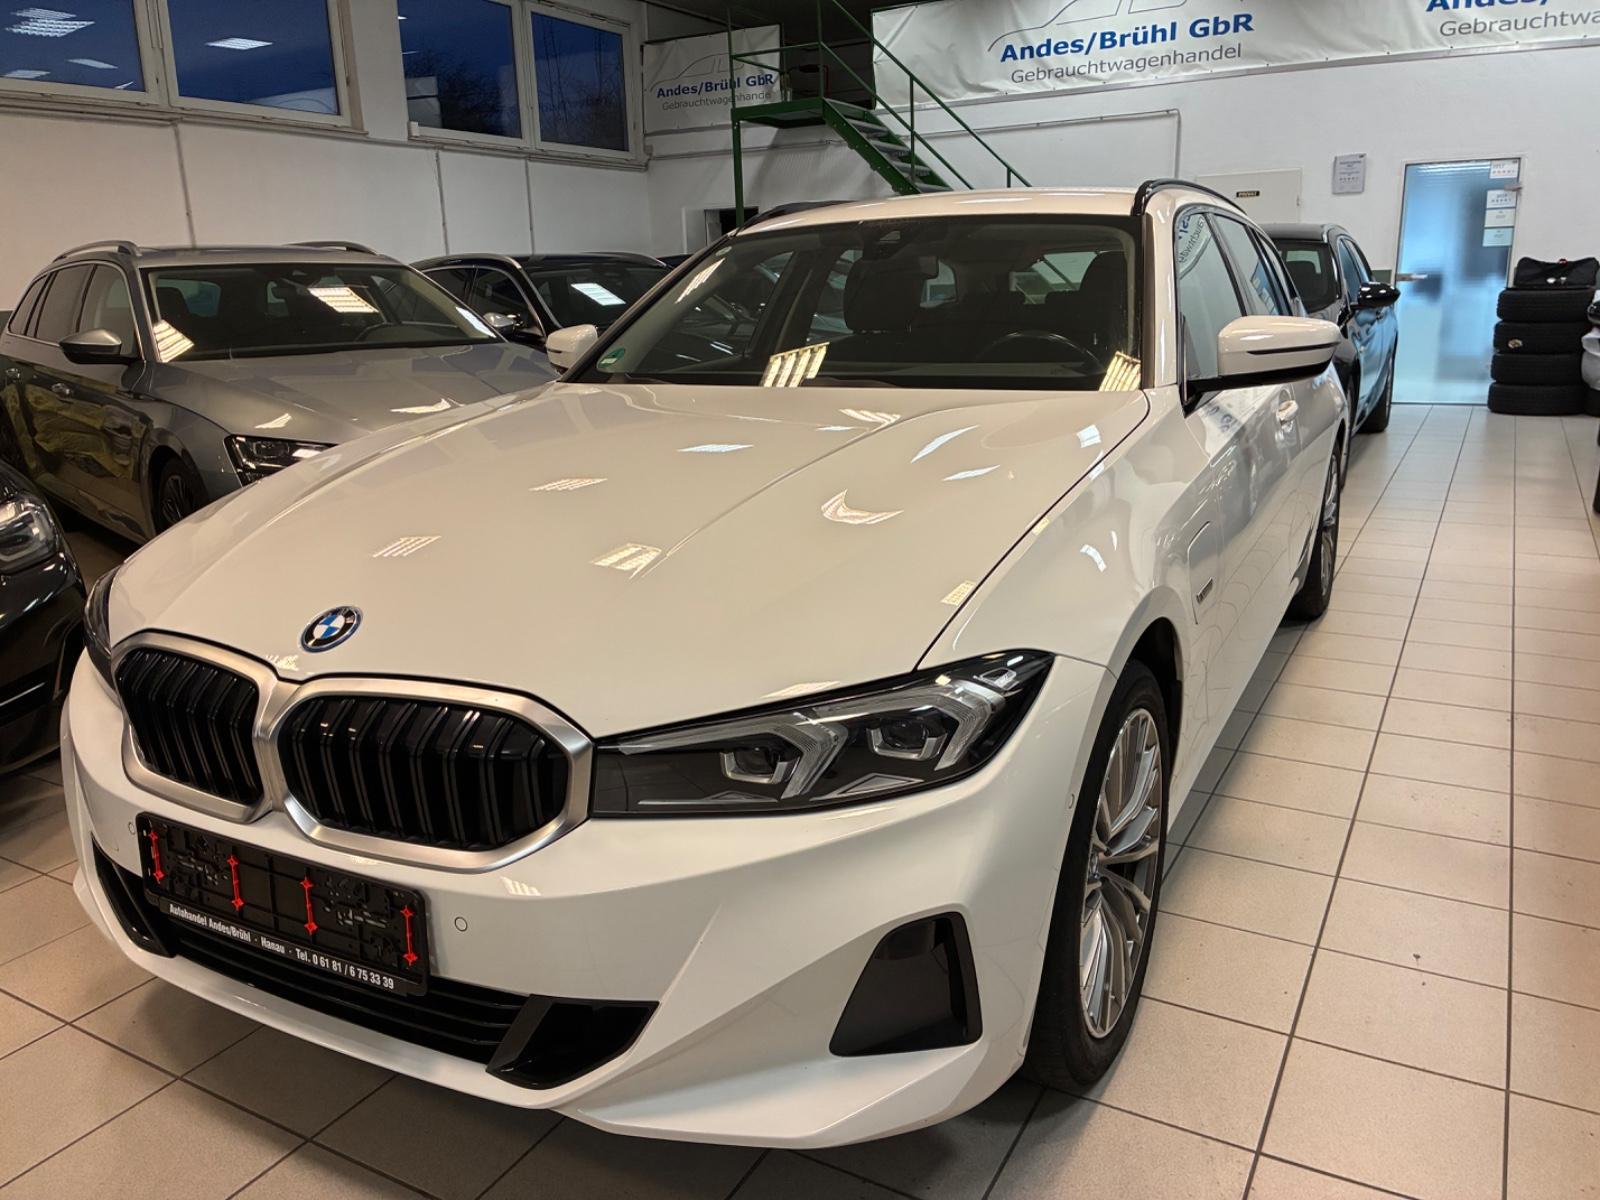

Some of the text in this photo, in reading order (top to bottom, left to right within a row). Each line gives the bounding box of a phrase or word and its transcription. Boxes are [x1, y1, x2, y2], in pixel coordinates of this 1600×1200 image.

[1000, 13, 1255, 62] Andes/Brühl GbR
[745, 73, 774, 87] GbR
[1011, 43, 1242, 84] Gebrauchtwagenhandel
[169, 903, 207, 927] Autohandel
[209, 917, 251, 943] Andes/Brühl
[260, 936, 285, 954] Hanau
[295, 948, 311, 963] Tel.
[312, 953, 318, 965] 0
[319, 956, 330, 969] 61
[332, 960, 342, 973] 81
[349, 966, 356, 977] 6
[357, 968, 368, 982] 75
[370, 972, 381, 986] 33
[382, 976, 394, 990] 39
